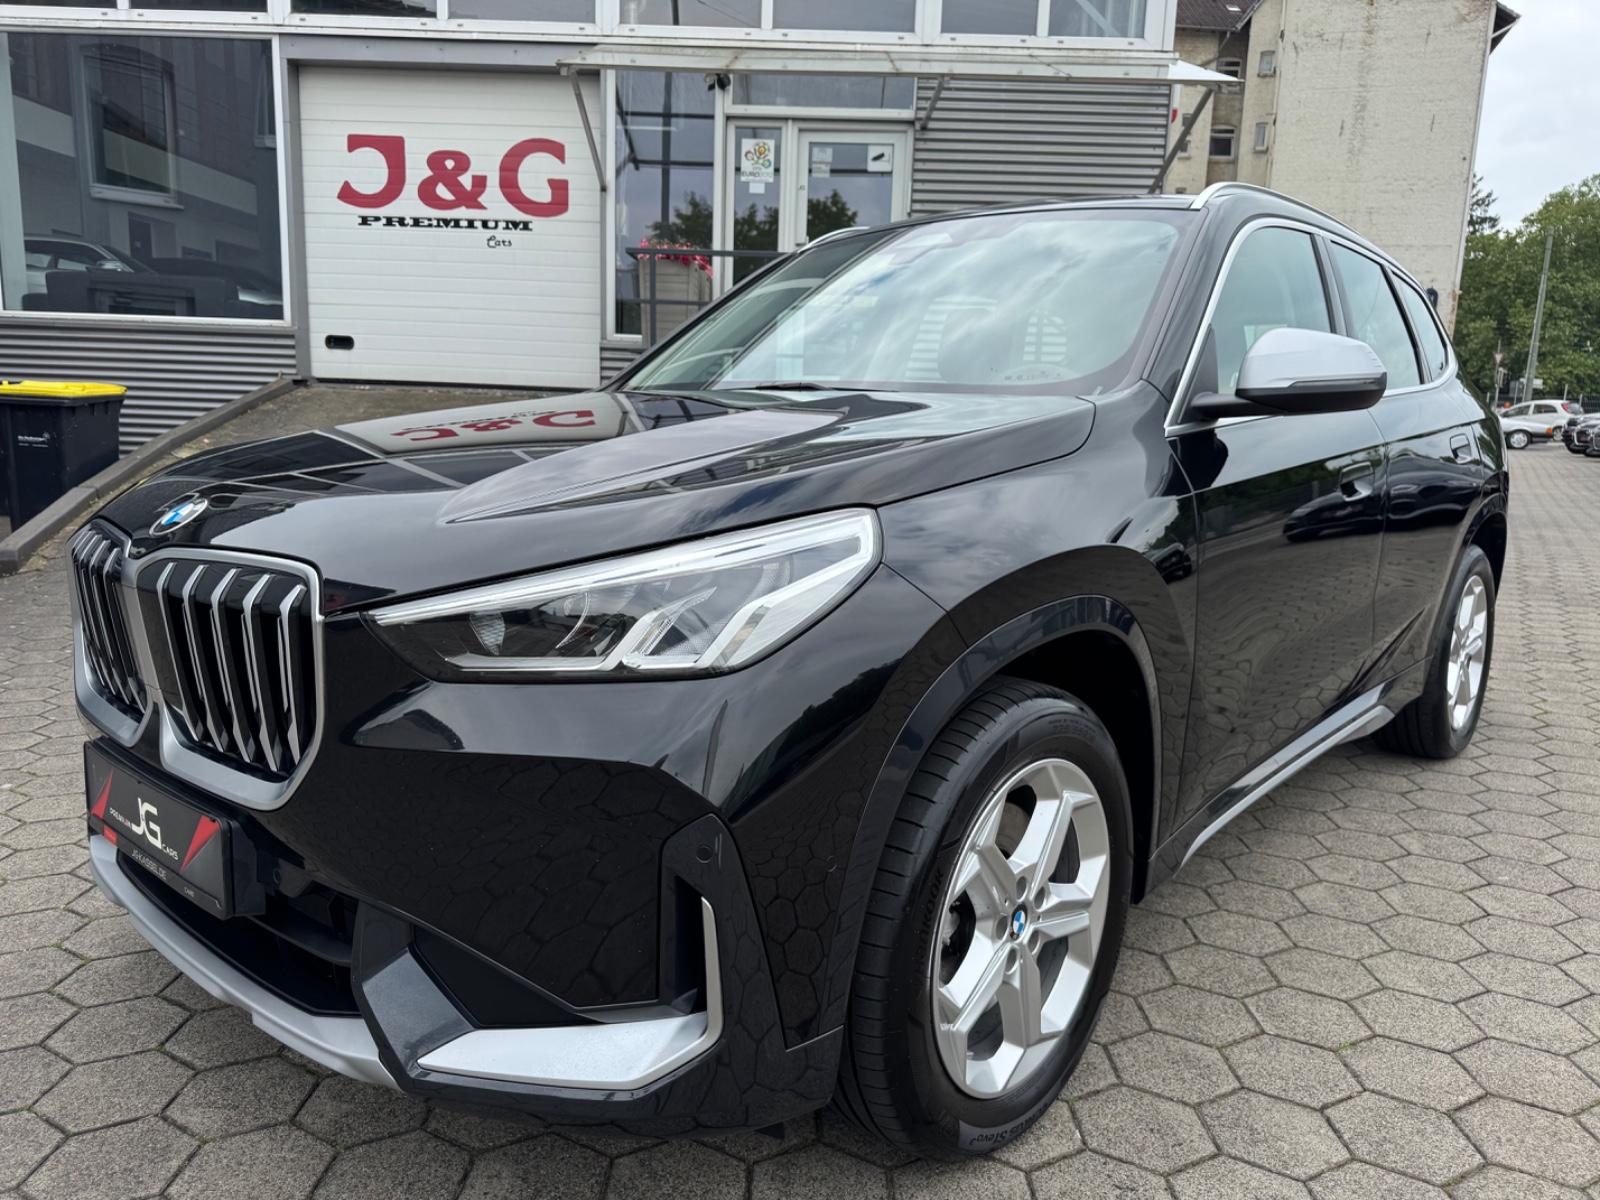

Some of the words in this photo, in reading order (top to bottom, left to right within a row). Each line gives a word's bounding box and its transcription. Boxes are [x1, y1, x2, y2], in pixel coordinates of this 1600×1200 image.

[337, 134, 569, 217] J&G
[358, 215, 533, 231] PREMIUM
[487, 236, 512, 248] Cars
